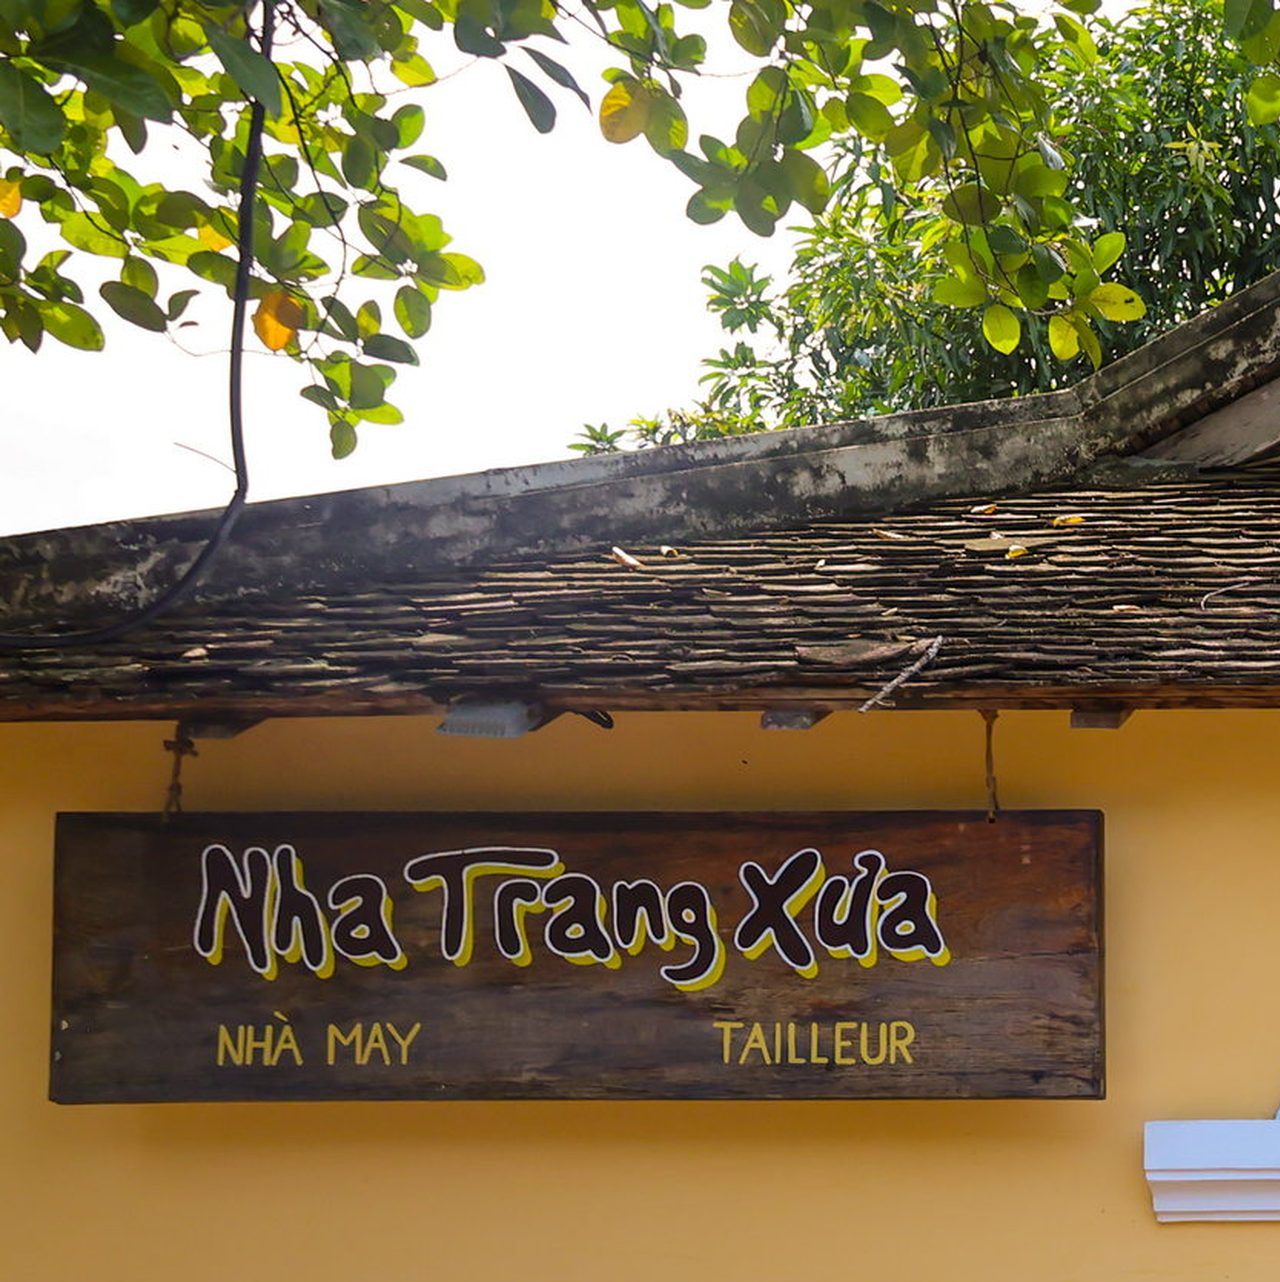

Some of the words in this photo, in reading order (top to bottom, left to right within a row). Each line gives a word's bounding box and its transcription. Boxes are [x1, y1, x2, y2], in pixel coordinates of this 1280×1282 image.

[195, 844, 402, 981] Nha
[402, 846, 727, 993] Trang
[217, 1011, 303, 1066] NHÀ
[327, 1023, 422, 1066] MAY
[716, 1020, 916, 1066] TAILLEUR
